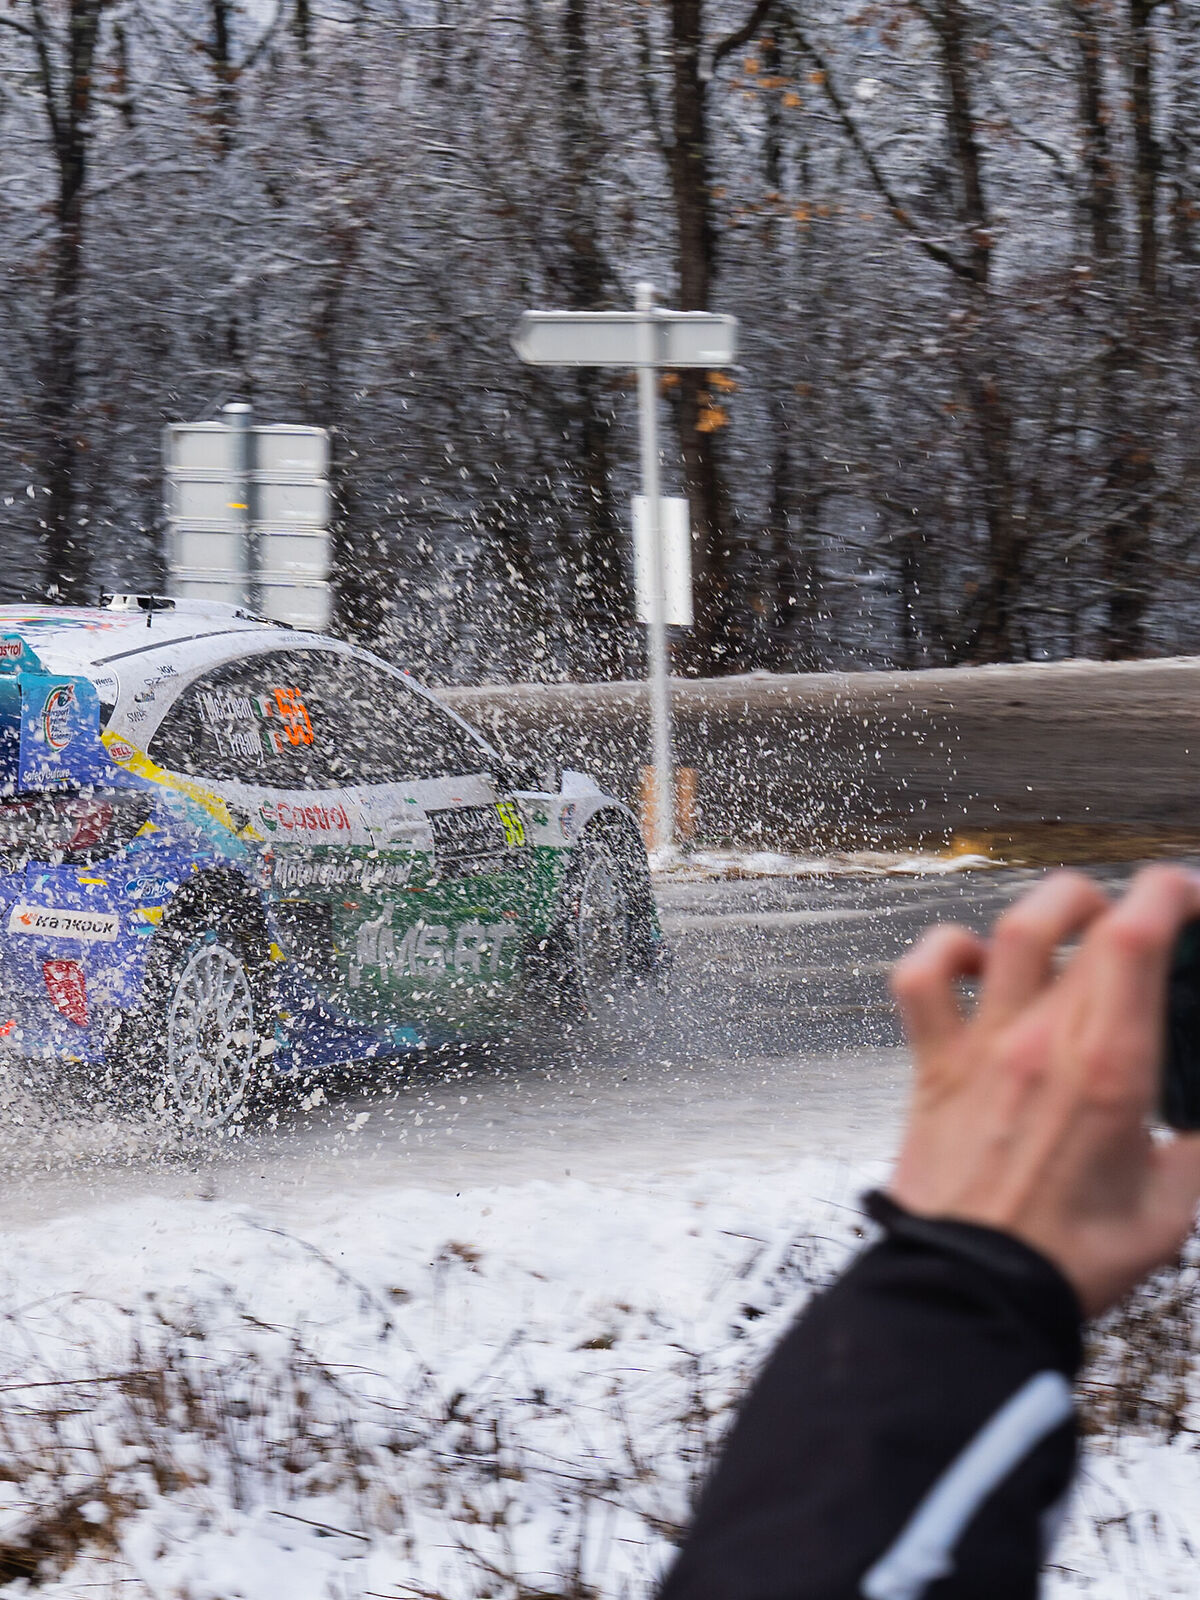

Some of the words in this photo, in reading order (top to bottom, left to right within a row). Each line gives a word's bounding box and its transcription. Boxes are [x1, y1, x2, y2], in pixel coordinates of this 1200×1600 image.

[274, 687, 315, 746] 55
[277, 802, 351, 831] Castrol
[496, 802, 526, 847] 55
